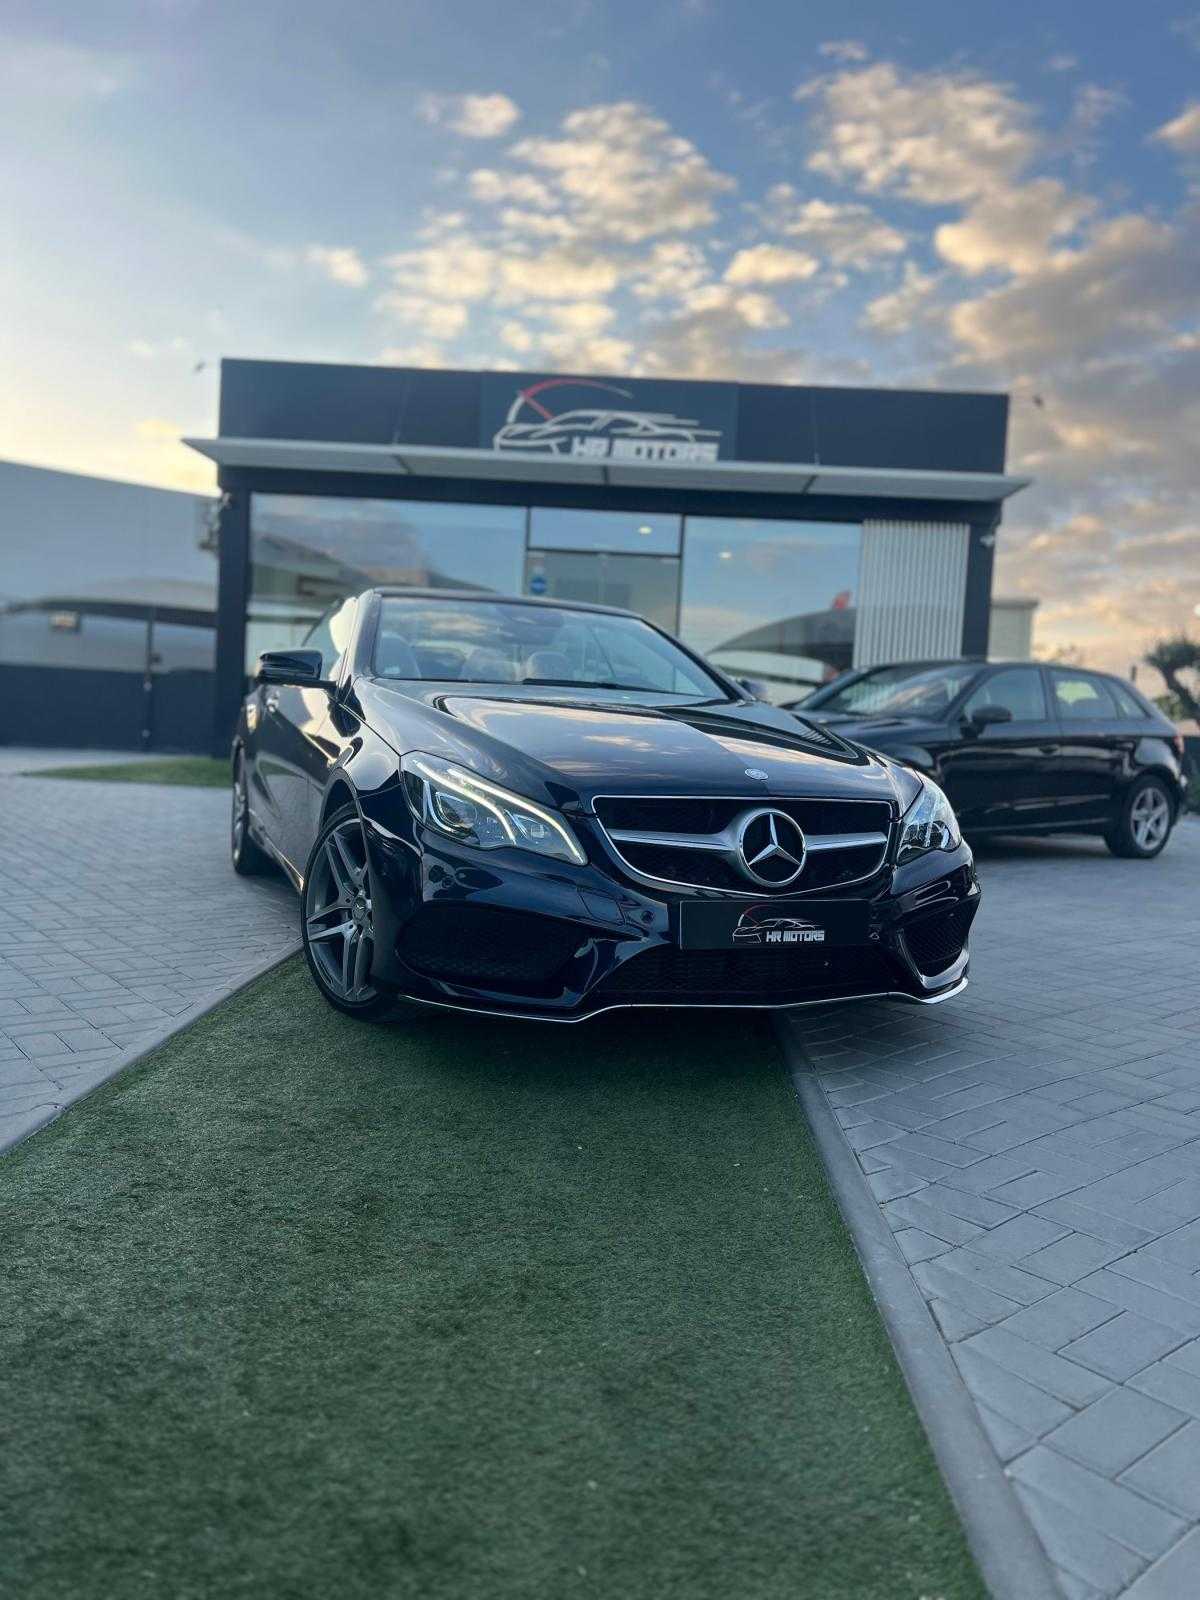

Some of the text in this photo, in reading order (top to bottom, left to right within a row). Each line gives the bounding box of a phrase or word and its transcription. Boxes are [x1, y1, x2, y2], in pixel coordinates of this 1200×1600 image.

[571, 436, 719, 462] HR MOTORS
[766, 930, 825, 942] HR MOTORS
